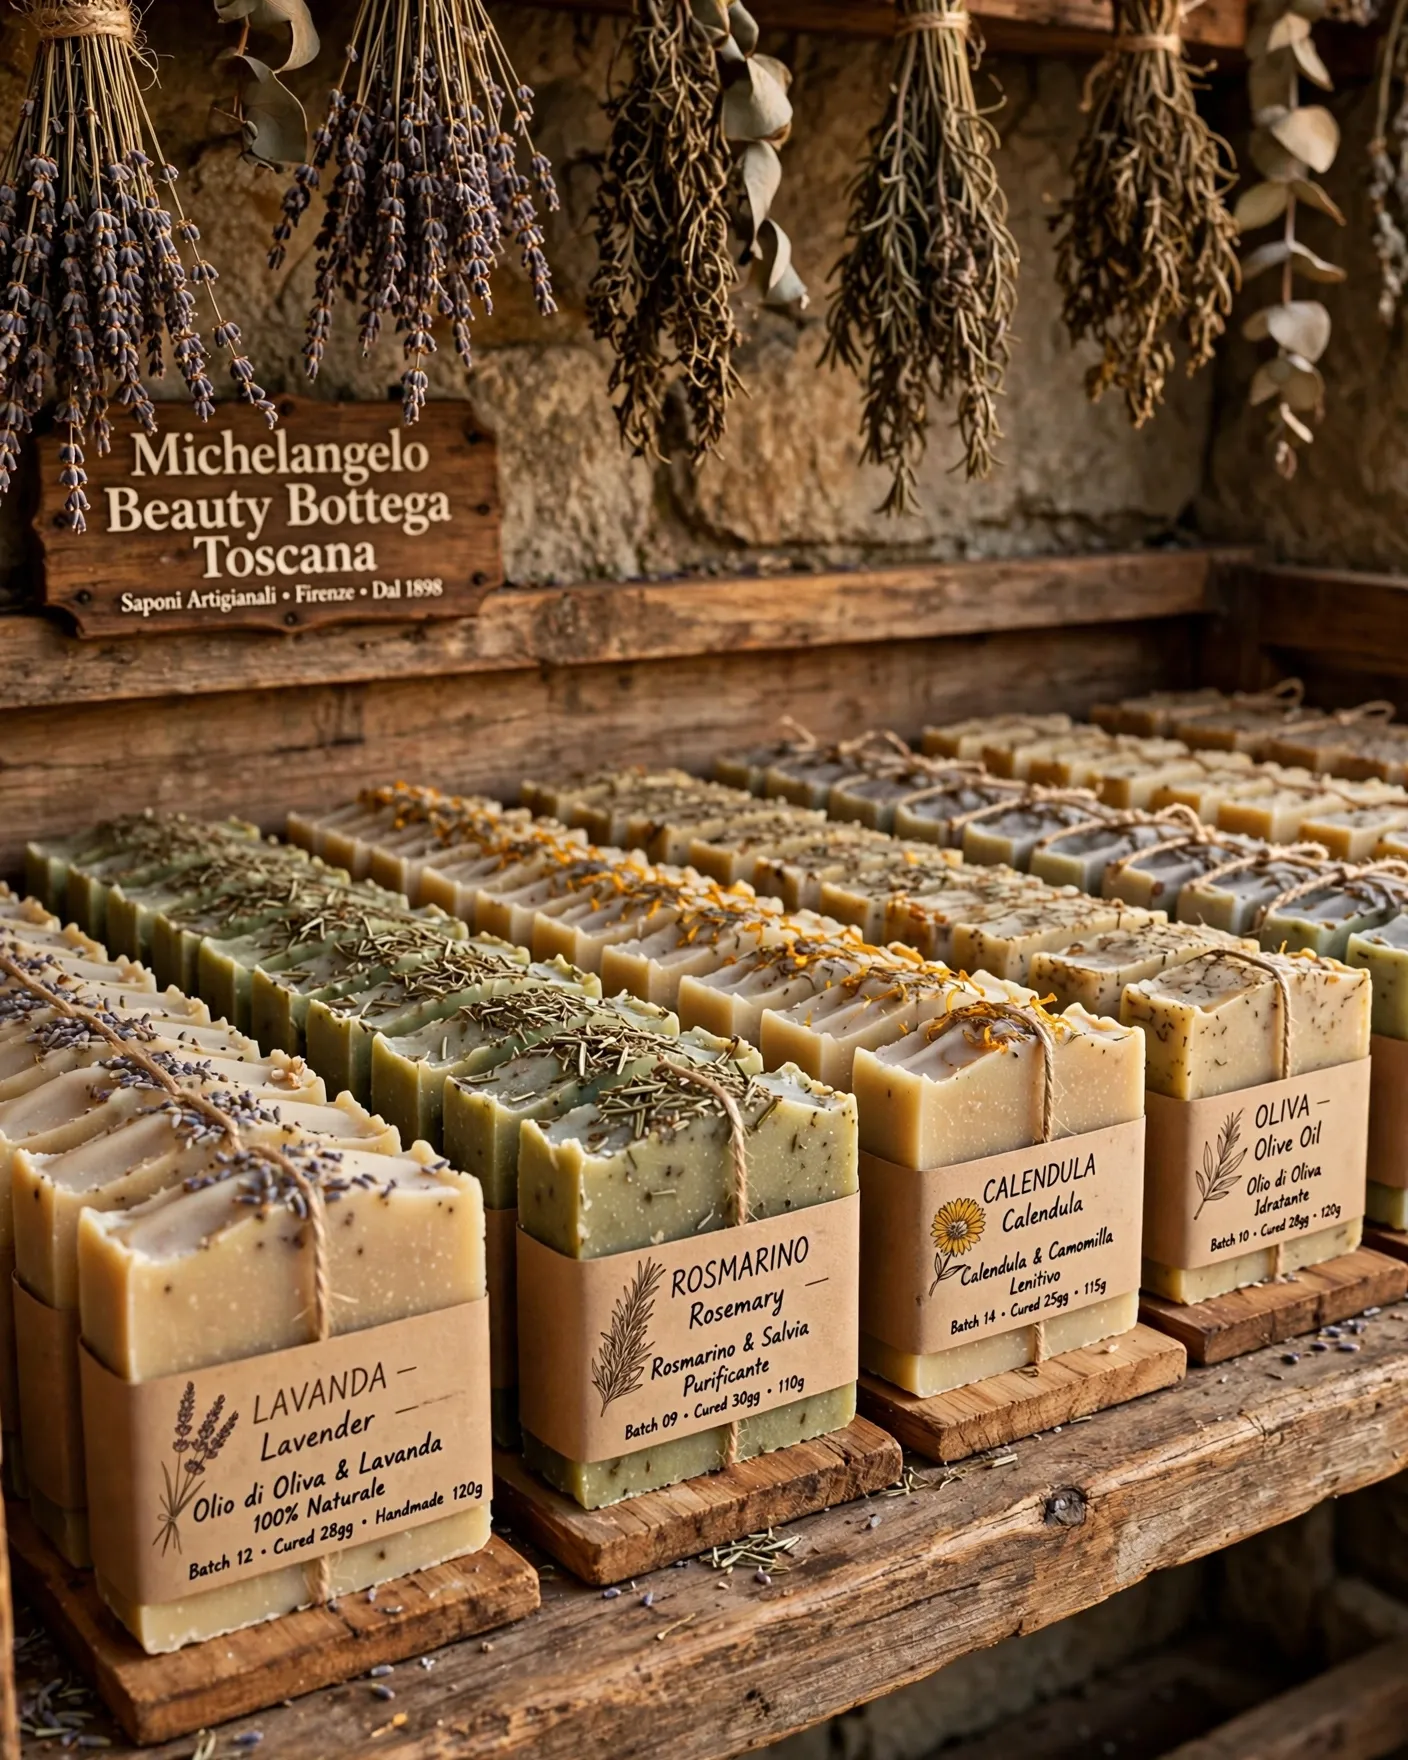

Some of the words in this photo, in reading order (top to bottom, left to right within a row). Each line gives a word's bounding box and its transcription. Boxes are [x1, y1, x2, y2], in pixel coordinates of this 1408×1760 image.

[131, 428, 429, 486] Michelangelo
[104, 487, 272, 541] Beauty
[285, 483, 451, 536] Bottega
[193, 536, 378, 578] Toscana
[121, 591, 182, 617] Saponi
[187, 586, 277, 612] Artigianali
[296, 584, 355, 603] Firenze
[372, 580, 400, 599] Dal
[406, 578, 443, 598] 1898
[1255, 1094, 1309, 1129] OLIVA
[1254, 1134, 1293, 1161] Olive
[1300, 1120, 1322, 1148] Oil
[983, 1153, 1096, 1204] CALENDULA
[1247, 1174, 1270, 1196] Olio
[1275, 1169, 1287, 1186] di
[1291, 1162, 1322, 1183] Oliva
[1254, 1189, 1309, 1216] Idratante
[1002, 1191, 1083, 1233] Calendula
[1210, 1235, 1235, 1252] Batch
[1239, 1229, 1249, 1242] 10
[1260, 1219, 1285, 1237] Cured
[1289, 1214, 1309, 1230] 28gg
[1321, 1204, 1341, 1219] 120g
[672, 1236, 809, 1298] ROSMARINO
[961, 1251, 1027, 1286] Calendula
[1033, 1247, 1042, 1265] &
[1048, 1226, 1114, 1261] Camomilla
[951, 1317, 979, 1335] Batch
[984, 1309, 995, 1325] 14
[1010, 1297, 1040, 1317] Cured
[1044, 1291, 1069, 1309] 25gg
[1085, 1278, 1107, 1295] 115g
[1010, 1270, 1061, 1295] Lenitivo
[689, 1289, 784, 1329] Rosemary
[651, 1344, 735, 1380] Rosmarino
[743, 1333, 754, 1352] &
[761, 1320, 809, 1346] Salvia
[253, 1362, 387, 1425] LAVANDA
[683, 1358, 769, 1397] Purificante
[625, 1417, 658, 1440] Batch
[662, 1412, 678, 1428] 09
[694, 1396, 727, 1419] Cured
[732, 1391, 760, 1406] 30gg
[779, 1375, 804, 1393] 110g
[260, 1410, 375, 1461] Lavender
[193, 1494, 234, 1522] Olio
[245, 1482, 263, 1507] di
[273, 1471, 326, 1499] Oliva
[336, 1459, 348, 1480] &
[359, 1431, 442, 1475] Lavanda
[189, 1551, 230, 1580] Batch
[237, 1548, 253, 1566] 12
[273, 1533, 314, 1555] Cured
[320, 1522, 354, 1542] 28gg
[375, 1492, 444, 1524] Handmade
[453, 1481, 483, 1500] 120g
[254, 1504, 298, 1533] 100%
[307, 1477, 385, 1518] Naturale
